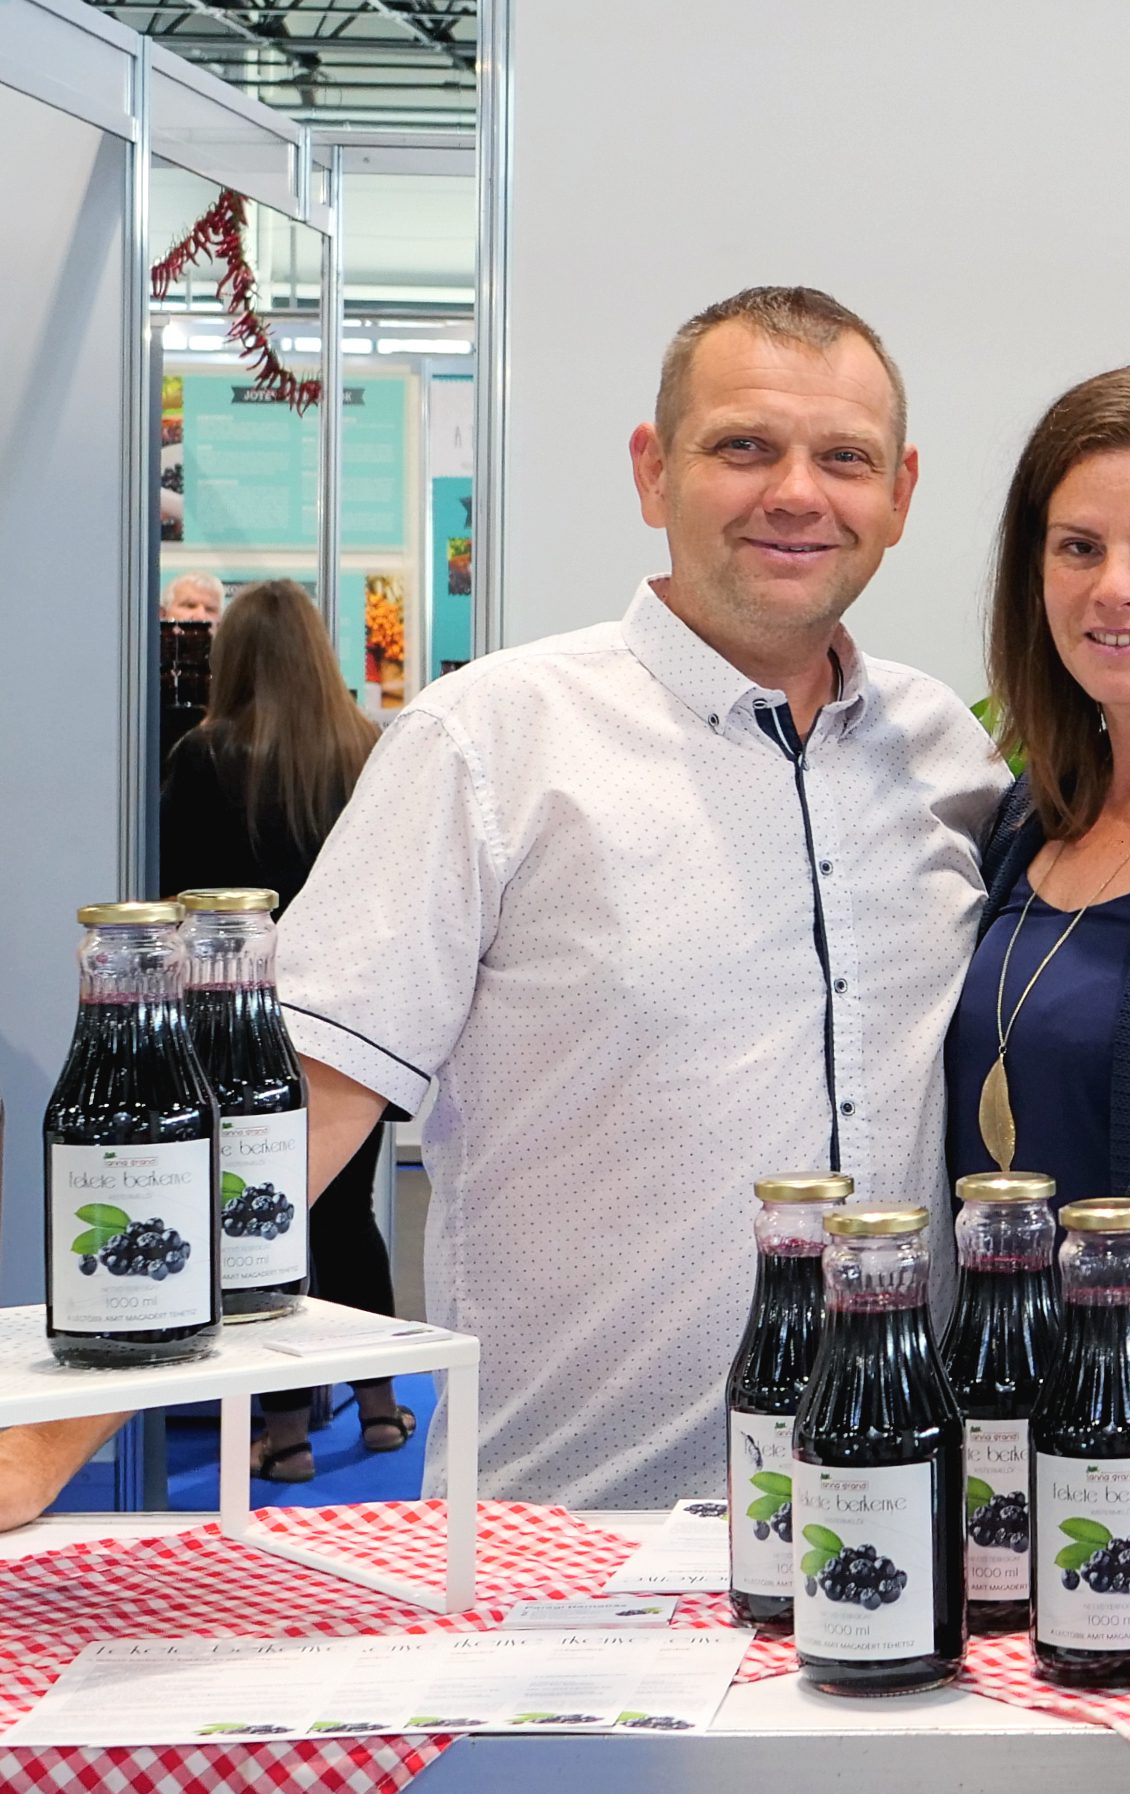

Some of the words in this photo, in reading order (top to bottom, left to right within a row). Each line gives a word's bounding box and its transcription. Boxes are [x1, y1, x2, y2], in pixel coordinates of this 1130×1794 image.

[223, 1257, 253, 1268] 1000
[105, 1297, 140, 1309] 1000
[142, 1296, 158, 1307] ml
[972, 1567, 1002, 1578] 1000
[1004, 1567, 1019, 1577] ml
[1087, 1615, 1120, 1626] 1000
[855, 1624, 870, 1636] ml
